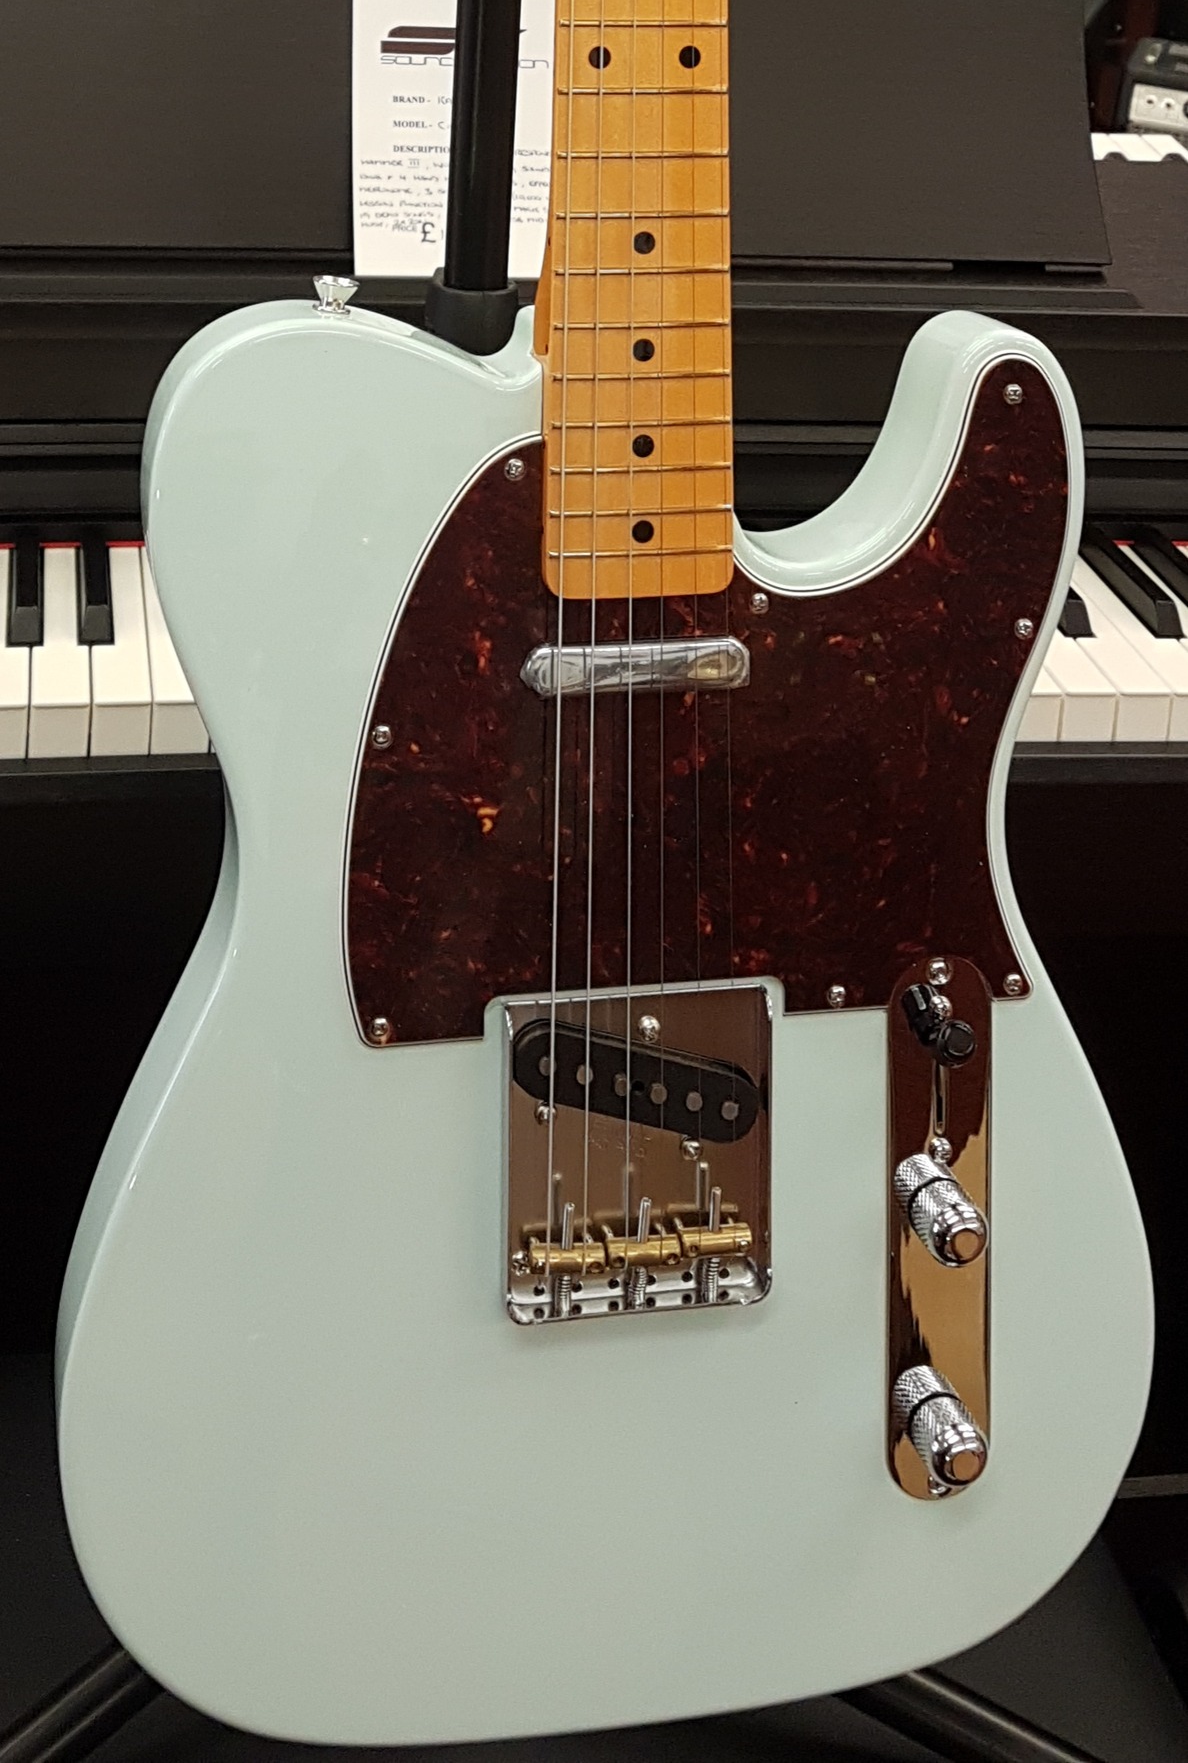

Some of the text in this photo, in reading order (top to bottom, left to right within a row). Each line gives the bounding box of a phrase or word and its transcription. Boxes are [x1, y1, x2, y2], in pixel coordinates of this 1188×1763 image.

[393, 96, 425, 104] BRAND
[393, 120, 427, 128] MODEL
[393, 145, 450, 154] DESCRIPTIO
